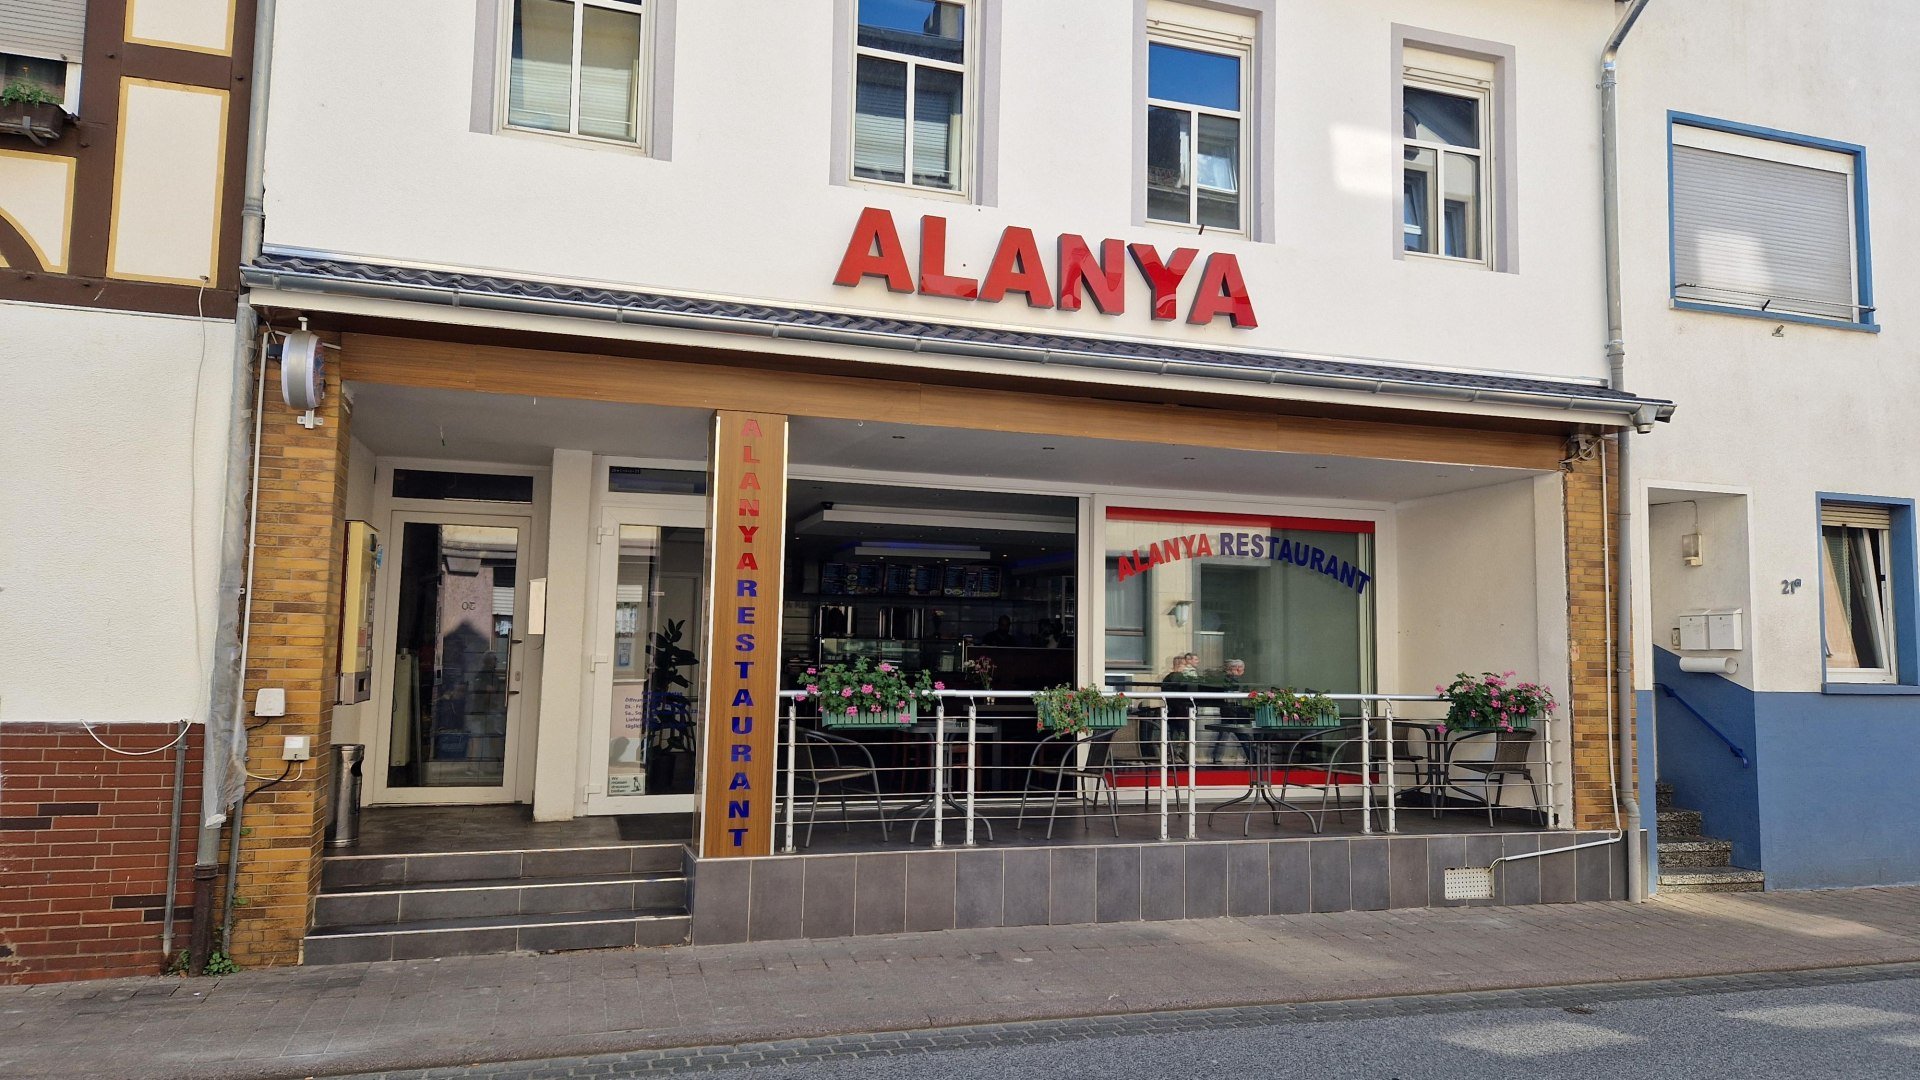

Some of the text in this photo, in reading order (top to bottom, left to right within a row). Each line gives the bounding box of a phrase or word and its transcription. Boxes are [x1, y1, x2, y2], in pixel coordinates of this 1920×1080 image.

[832, 206, 1259, 330] ALANYA
[1117, 532, 1371, 595] ALANYA RESTAURANT
[727, 418, 763, 848] ALANYA RESTAURANT
